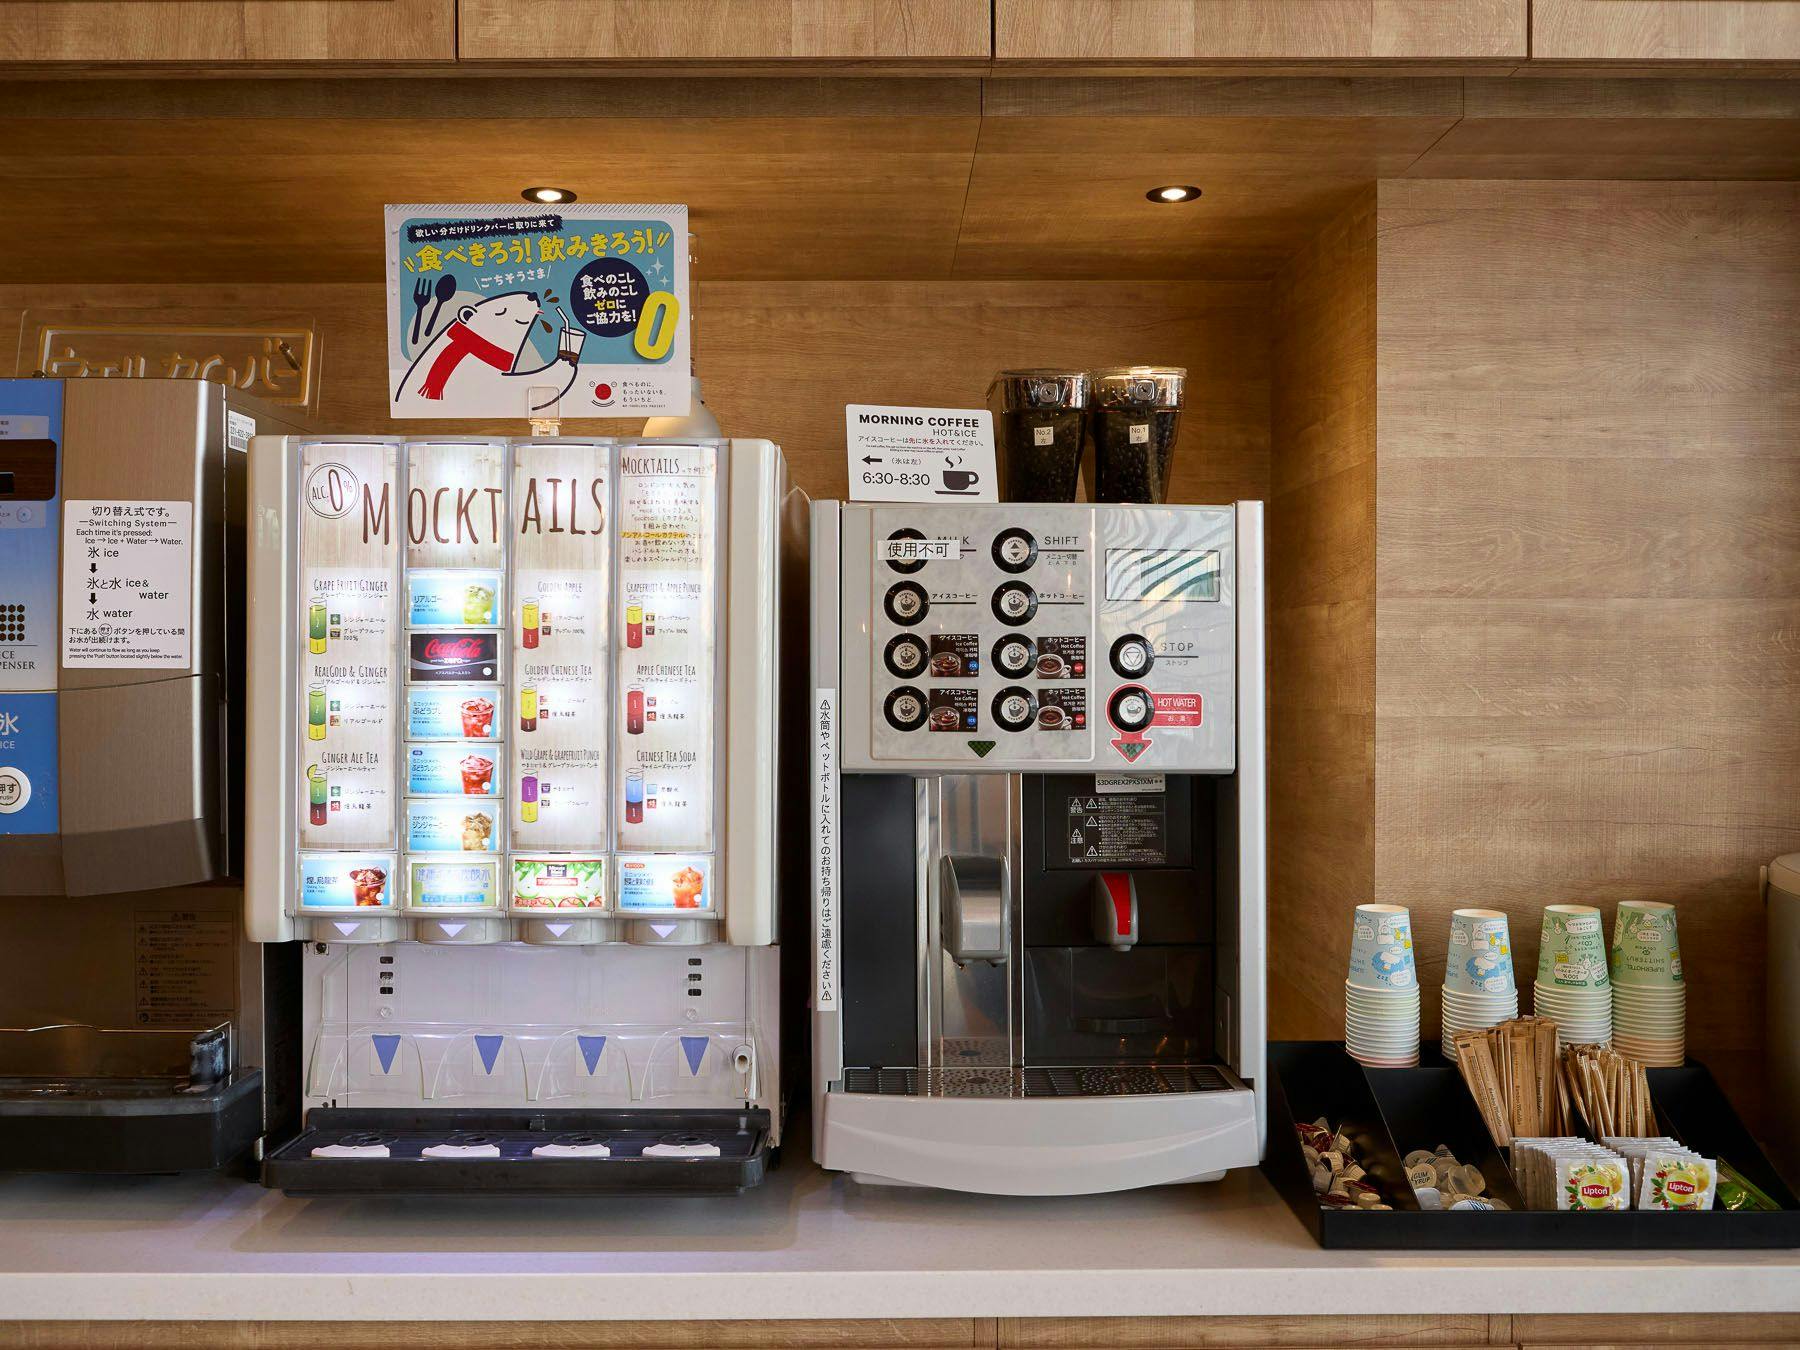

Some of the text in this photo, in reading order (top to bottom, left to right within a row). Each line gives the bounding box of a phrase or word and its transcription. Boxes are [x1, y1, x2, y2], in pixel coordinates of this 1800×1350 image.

[415, 219, 555, 238] 欲しい分だけドリンクバーに取りに来て
[480, 269, 547, 288] ごちそうさま
[580, 272, 636, 288] 食べのこし
[583, 285, 638, 300] 飲みのこし
[595, 300, 627, 310] ゼロに
[859, 414, 979, 428] MORNING COFFEE
[932, 429, 977, 438] HOT&ICE
[858, 436, 984, 447] アイスコーヒーは先に氷を入れてください。
[622, 457, 679, 474] MOCKTAILS
[863, 472, 930, 486] 6:30-8:30
[92, 506, 170, 517] 切り替え式です。
[1044, 536, 1079, 545] SHIFT
[88, 547, 119, 559] 氷 ice
[888, 542, 950, 558] 使用不可
[86, 577, 122, 590] 氷と水
[139, 592, 169, 600] water
[86, 608, 133, 621] 水 water
[1161, 643, 1194, 651] STOP
[359, 665, 387, 678] GINGER
[524, 664, 592, 675] GOLDEN CHINESE TEA
[637, 664, 696, 676] APPLE CHINESE TEA
[1158, 698, 1196, 707] HOT WATER
[322, 752, 379, 764] GINGER ALE TEA
[636, 750, 696, 762] CHINESE TEA SODA
[1583, 1188, 1607, 1196] Lipton
[1669, 1183, 1694, 1192] Lipton
